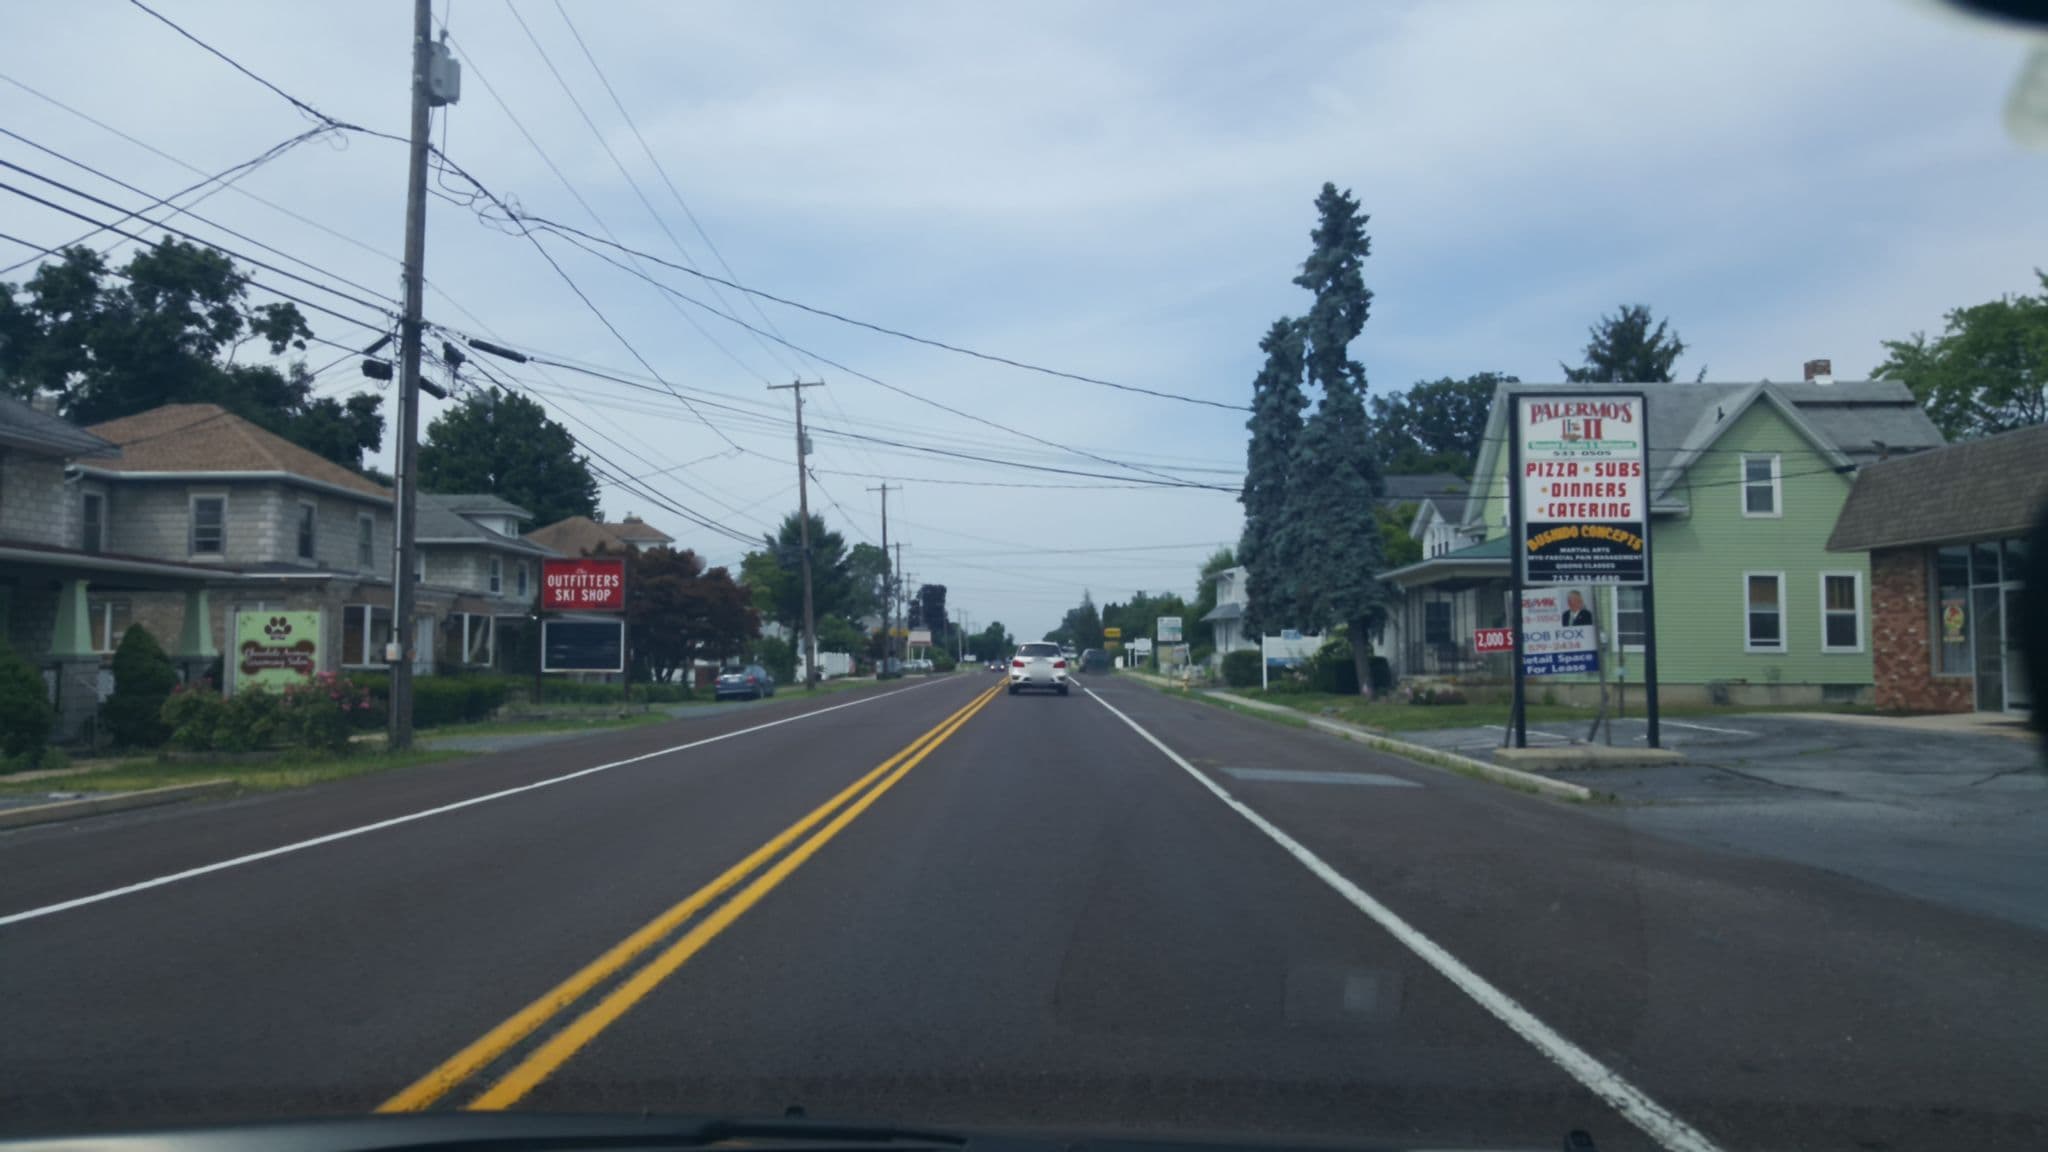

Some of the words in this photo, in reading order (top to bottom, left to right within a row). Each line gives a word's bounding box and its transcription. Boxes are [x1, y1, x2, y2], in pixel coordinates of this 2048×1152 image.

[1530, 402, 1632, 424] PALERMO'S
[1526, 462, 1578, 477] PIZZA
[1595, 462, 1641, 477] SUBS
[1551, 483, 1627, 497] DINNERS
[1548, 503, 1630, 518] CATERING
[1580, 525, 1643, 551] CONCEPTS
[547, 574, 619, 587] OUTFITTERS
[555, 589, 575, 601] SKI
[582, 589, 611, 601] SHOP
[1477, 632, 1504, 647] 2,000
[1522, 631, 1551, 641] BOB
[1555, 629, 1584, 640] FOX
[1522, 655, 1553, 664] etail
[1557, 653, 1593, 663] Space
[1527, 665, 1546, 674] For
[1552, 663, 1586, 673] Lease
